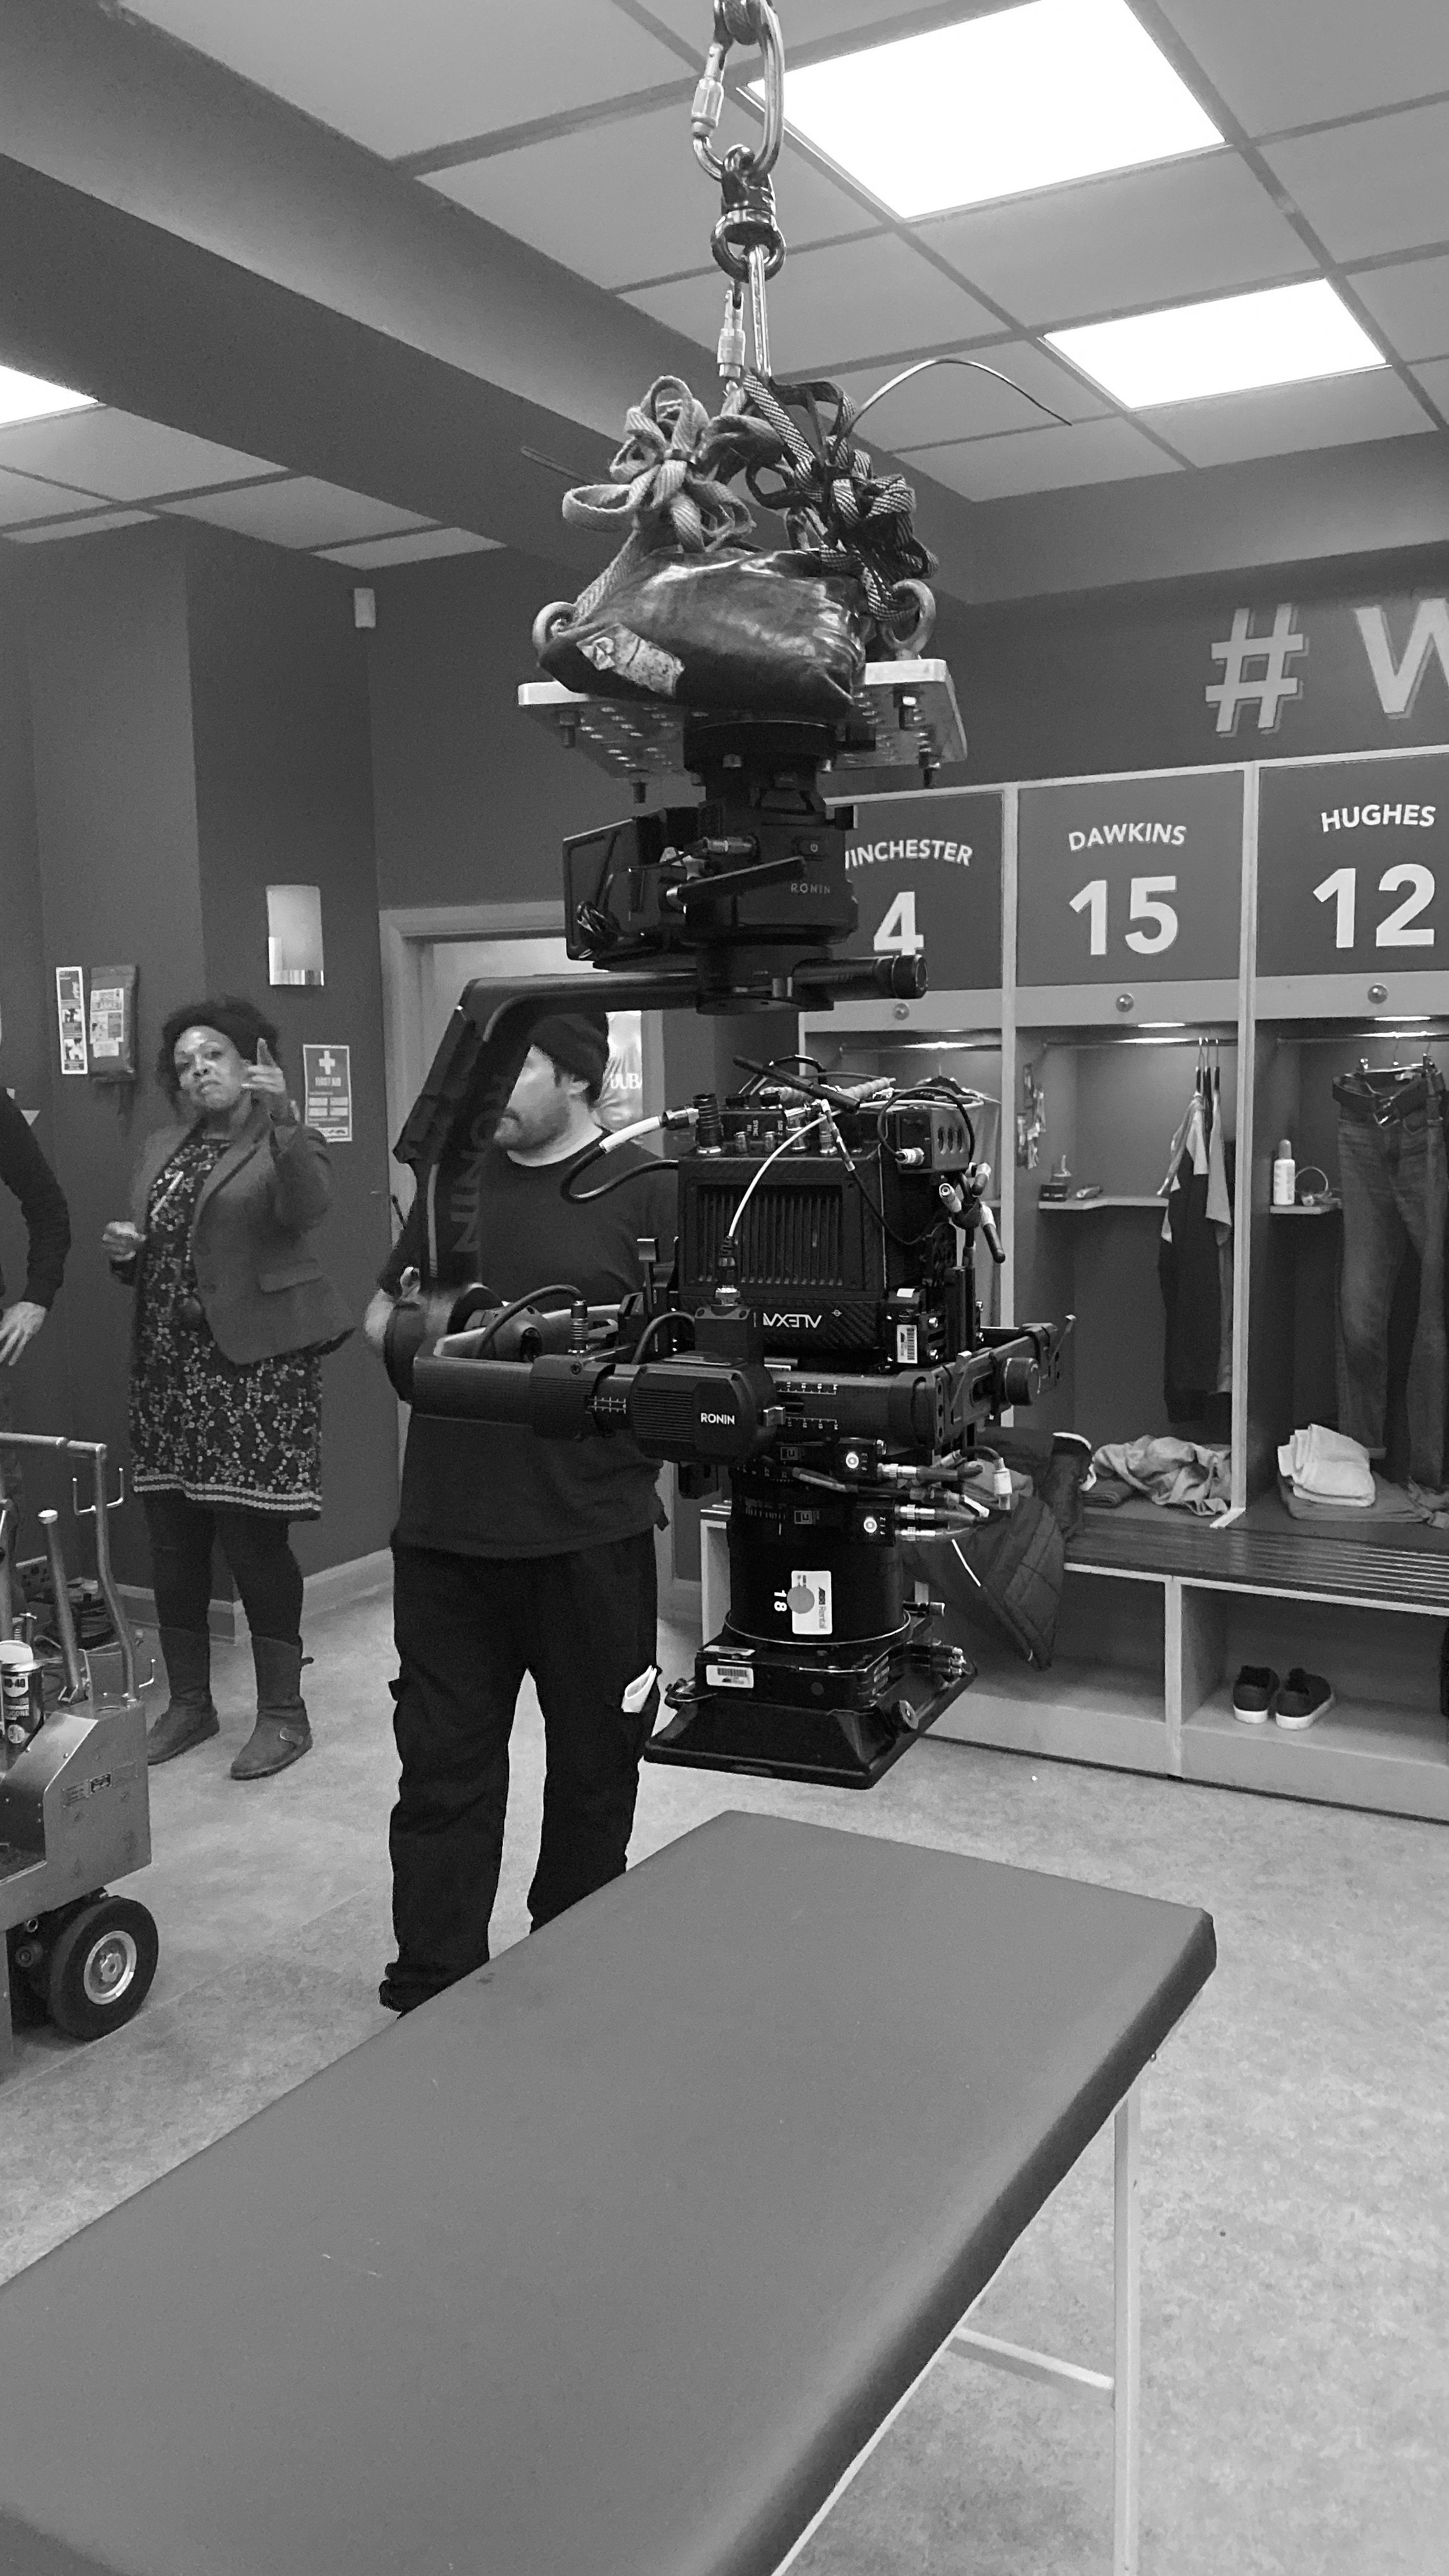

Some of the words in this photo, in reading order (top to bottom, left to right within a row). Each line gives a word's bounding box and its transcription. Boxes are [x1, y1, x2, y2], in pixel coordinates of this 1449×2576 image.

[1321, 804, 1436, 832] HUGHES
[1068, 822, 1186, 851] DAWKINS
[845, 839, 973, 871] INCHESTER
[790, 882, 831, 895] RONIN
[1069, 875, 1178, 955] 15
[1313, 863, 1435, 949] 12
[873, 891, 924, 956] 4
[762, 1312, 823, 1329] ALEXA
[700, 1413, 735, 1425] RONIN
[818, 1606, 827, 1629] Rental
